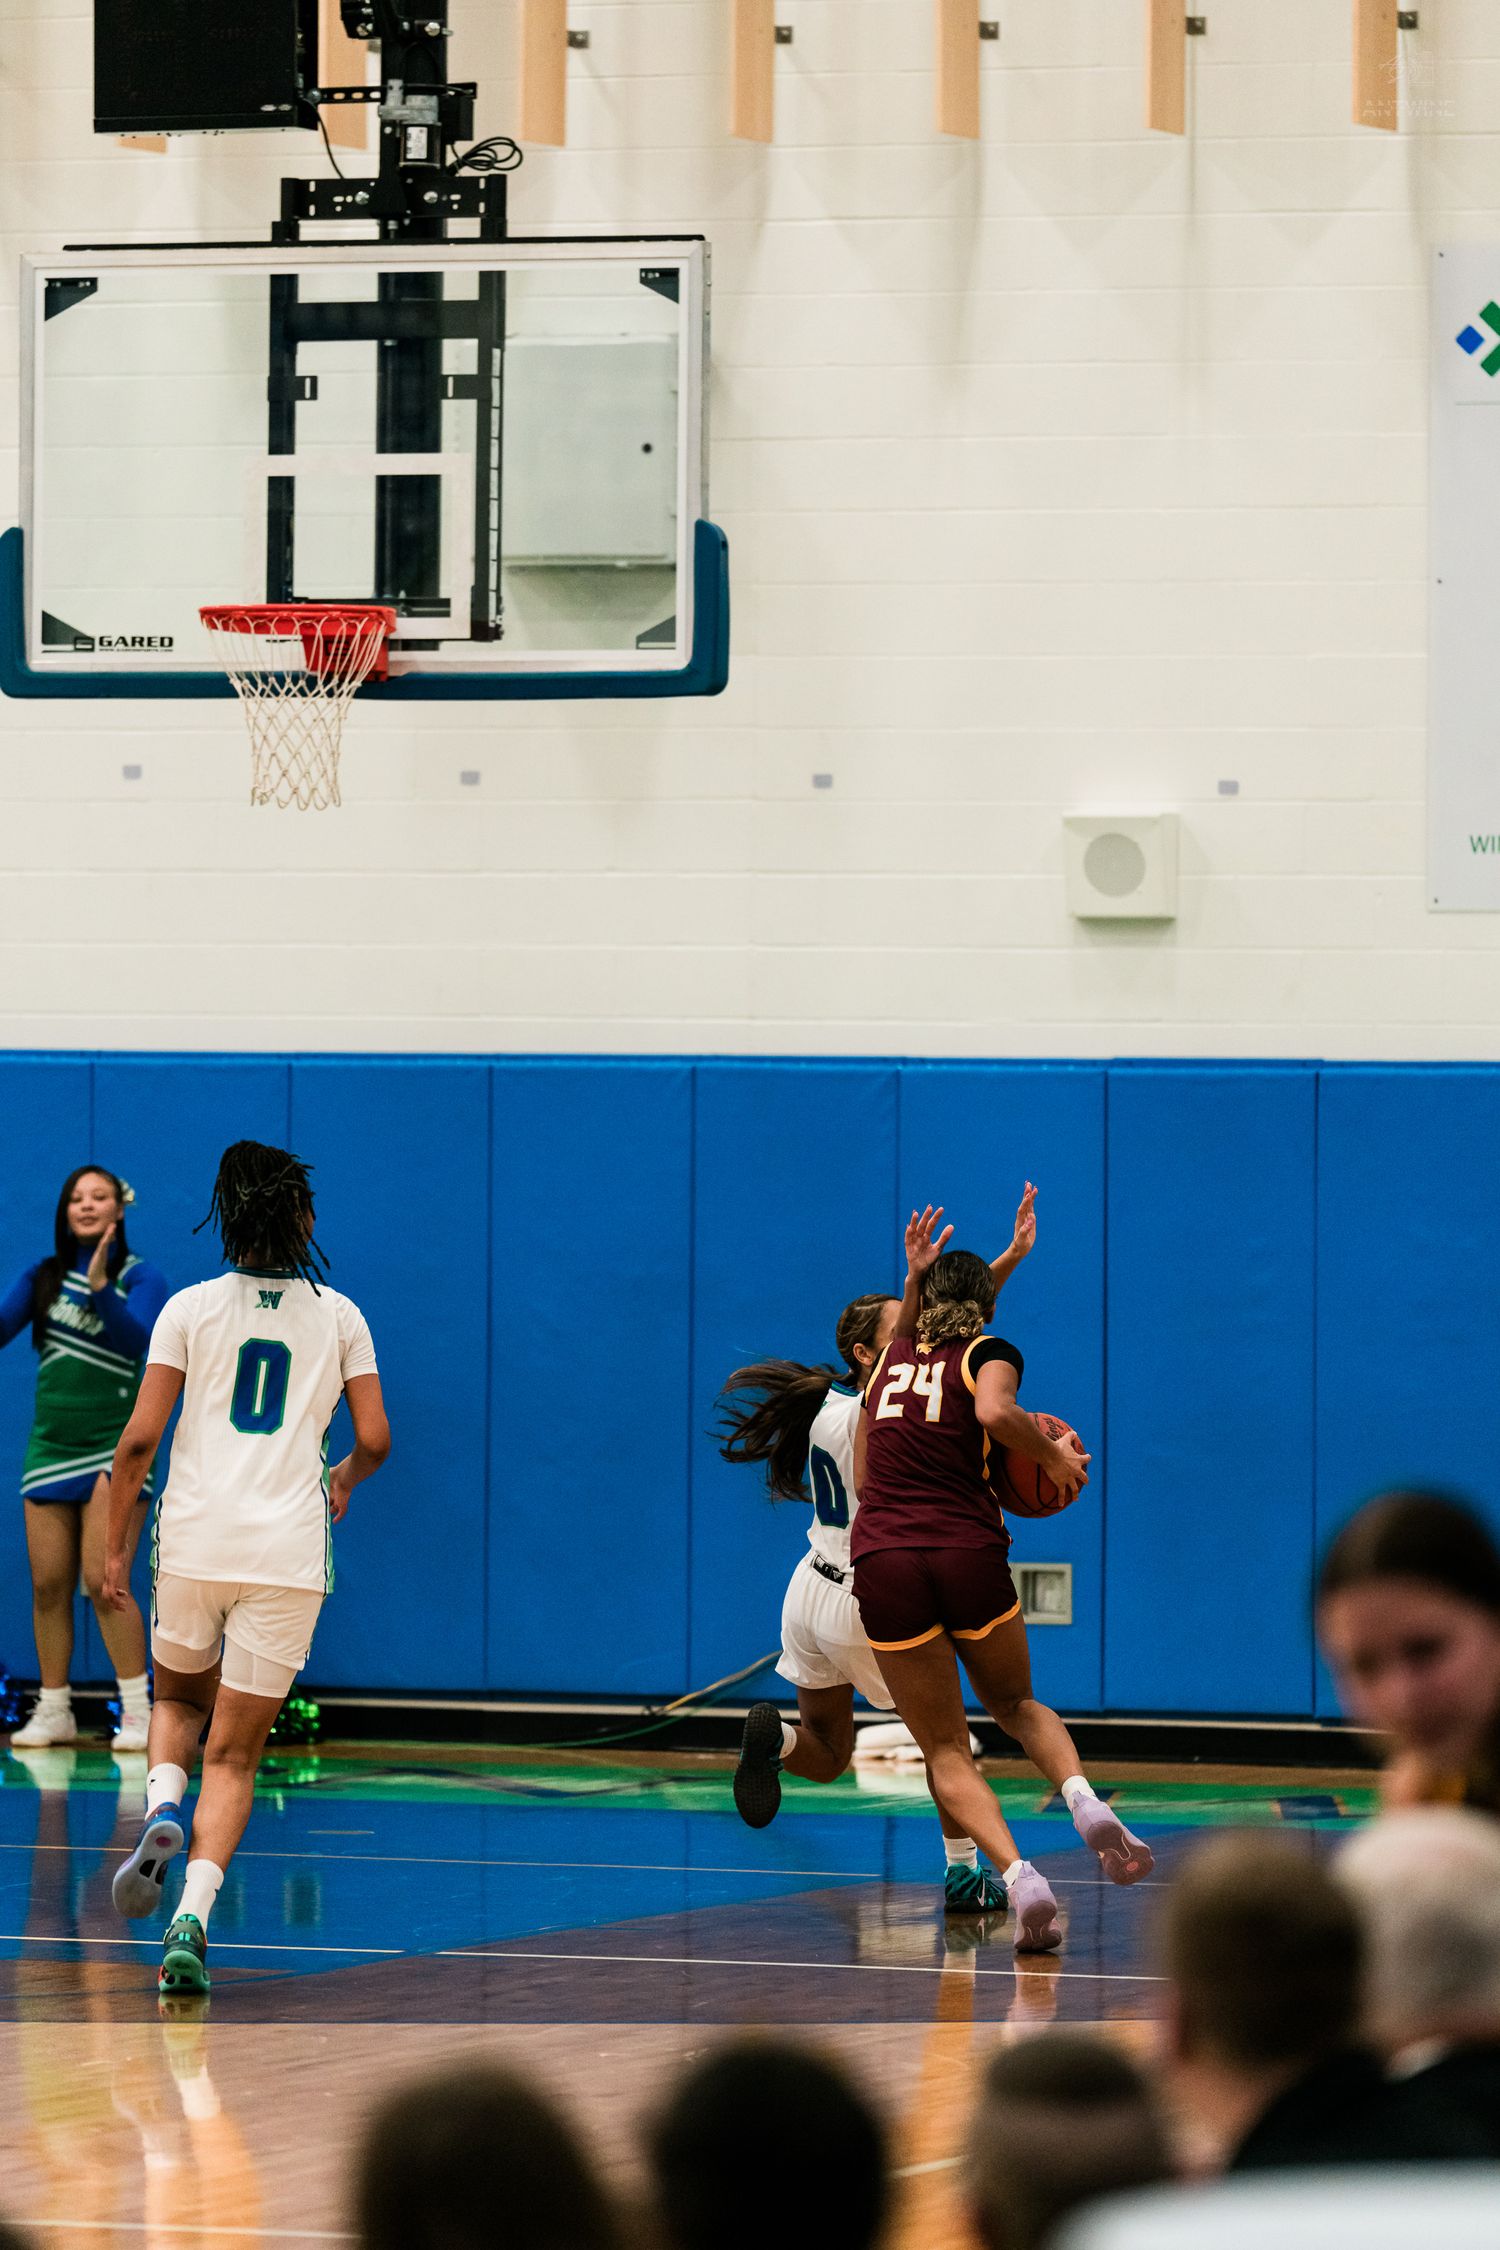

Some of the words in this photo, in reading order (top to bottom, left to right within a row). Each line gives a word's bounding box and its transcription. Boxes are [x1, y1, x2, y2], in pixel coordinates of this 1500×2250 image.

[98, 636, 174, 648] GARED
[1469, 834, 1500, 855] WI
[255, 1289, 286, 1310] W
[229, 1337, 293, 1436] 0
[875, 1360, 947, 1423] 24
[810, 1443, 850, 1530] 0
